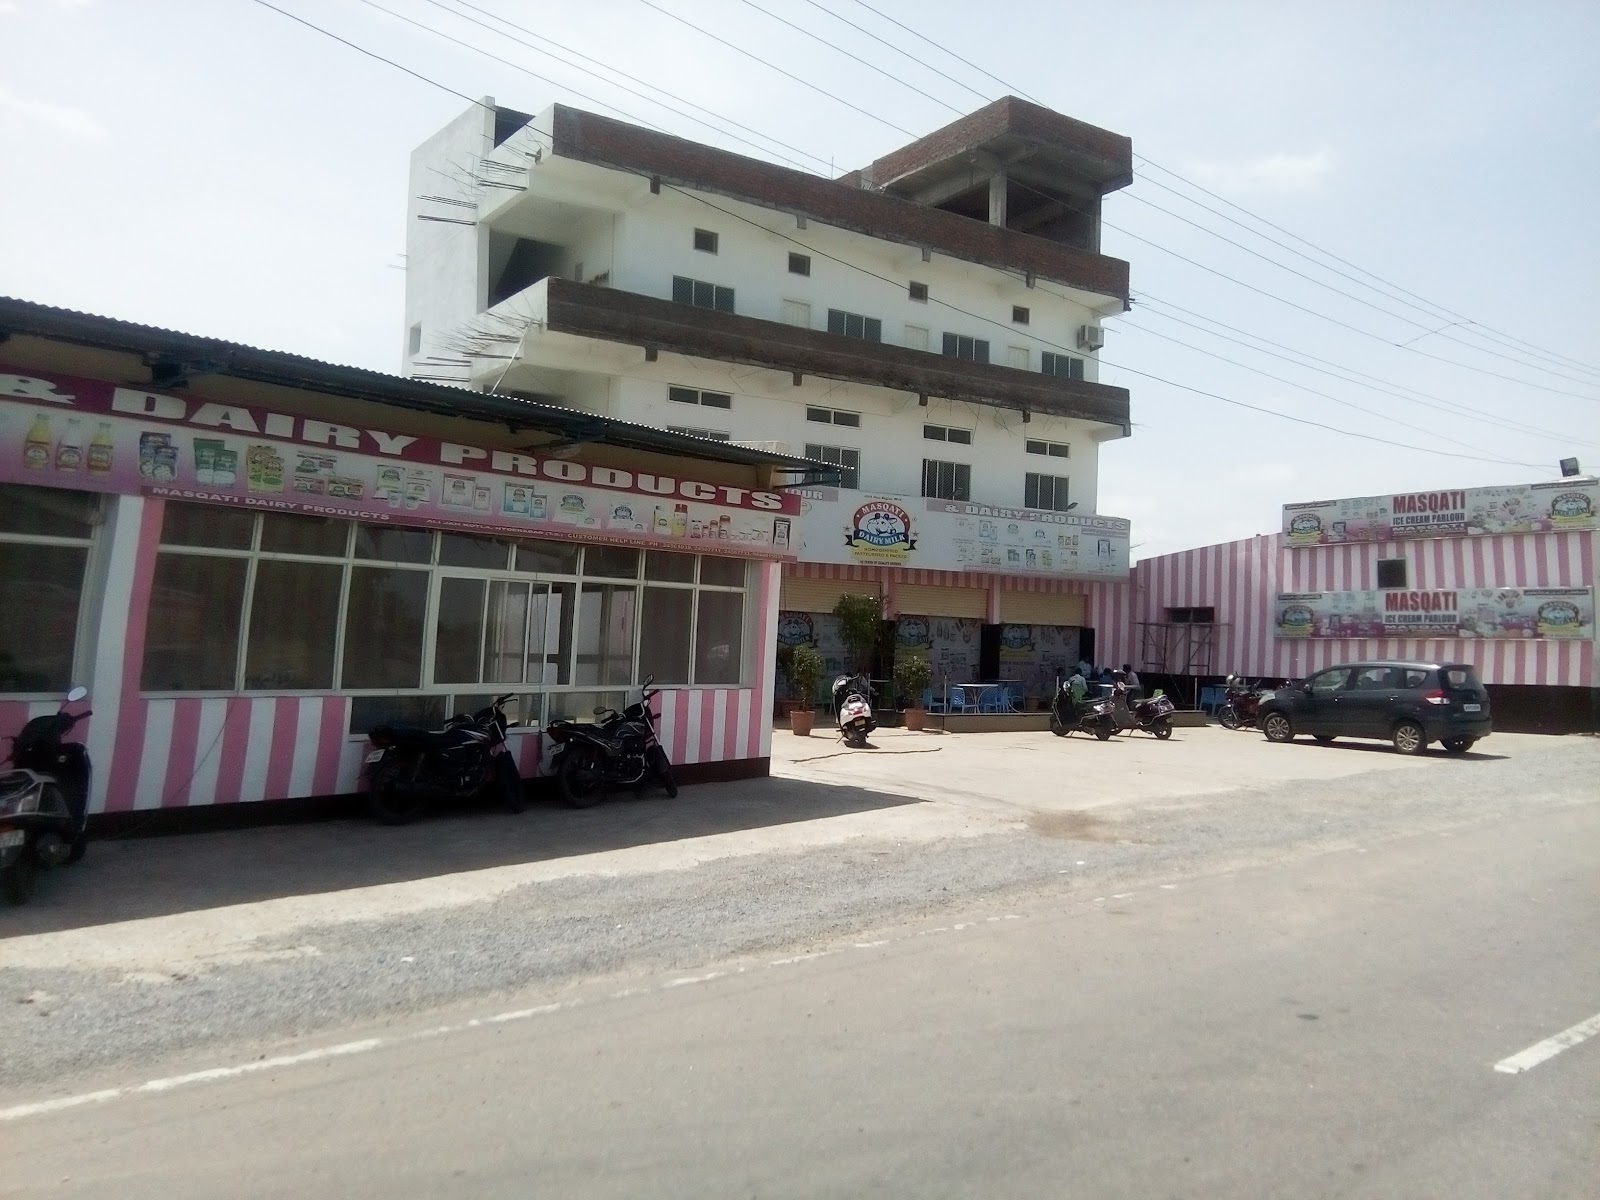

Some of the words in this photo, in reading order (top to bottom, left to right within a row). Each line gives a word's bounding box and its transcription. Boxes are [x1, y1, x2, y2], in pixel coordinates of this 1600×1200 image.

[0, 373, 76, 405] &
[112, 387, 419, 455] DAIRY
[440, 442, 783, 510] PRODUCTS
[152, 486, 239, 504] MASQATI
[244, 496, 299, 509] DAIRY
[303, 504, 391, 521] PRODUCTS
[861, 503, 904, 517] MASQATI
[1393, 491, 1466, 514] MASQATI
[944, 503, 960, 514] &
[965, 505, 1025, 520] DAIRY
[1029, 512, 1127, 531] PRODUCTS
[1393, 516, 1404, 526] ICE
[1405, 514, 1430, 525] CREAM
[1431, 512, 1465, 523] PARLOUR
[566, 532, 608, 542] CUSTOMER
[609, 537, 628, 545] HELP
[859, 531, 884, 544] DAIRY
[885, 535, 905, 544] MILK
[1385, 591, 1458, 613] MASQATI
[1385, 614, 1397, 623] ICE
[1398, 614, 1422, 623] CREAM
[1424, 614, 1457, 623] PARLOUR
